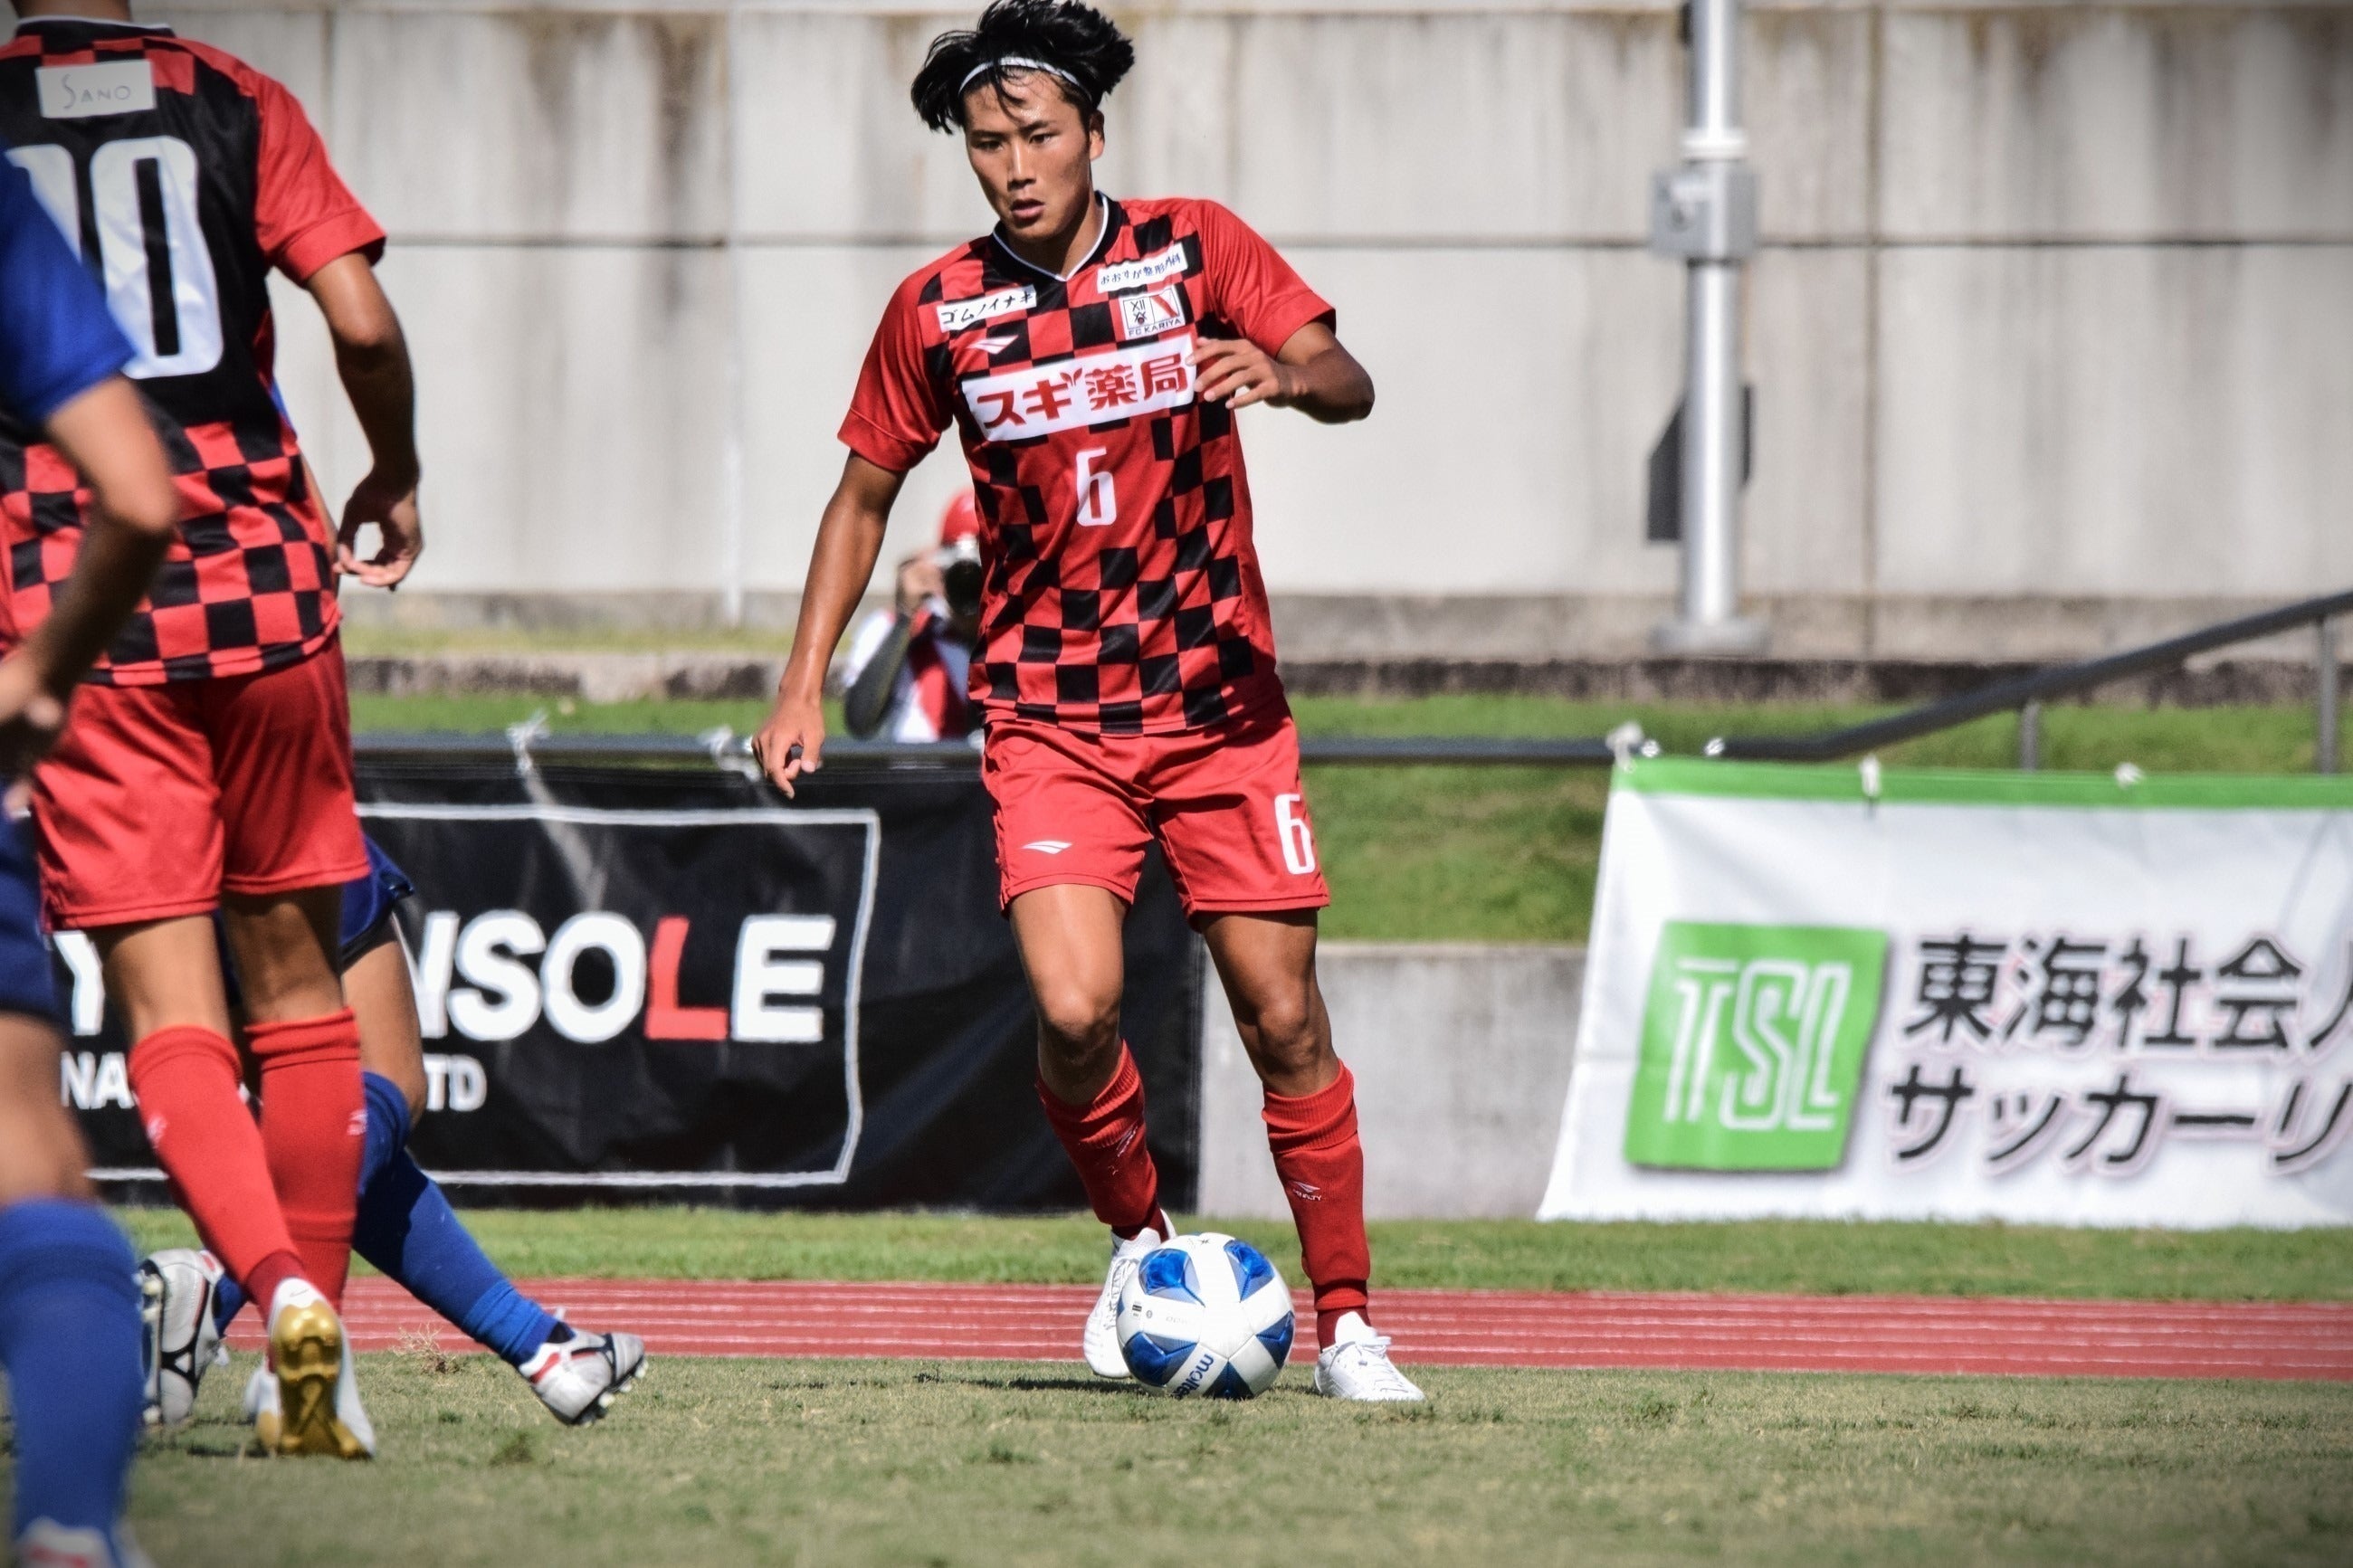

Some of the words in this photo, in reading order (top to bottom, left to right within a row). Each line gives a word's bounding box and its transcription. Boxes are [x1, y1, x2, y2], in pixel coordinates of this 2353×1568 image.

[940, 290, 1033, 324] ゴムノイナキ
[1129, 328, 1143, 337] FC
[1144, 318, 1182, 334] KARIYA
[976, 353, 1188, 430] スギ薬局
[1075, 446, 1118, 527] 6
[1274, 793, 1316, 876] 6
